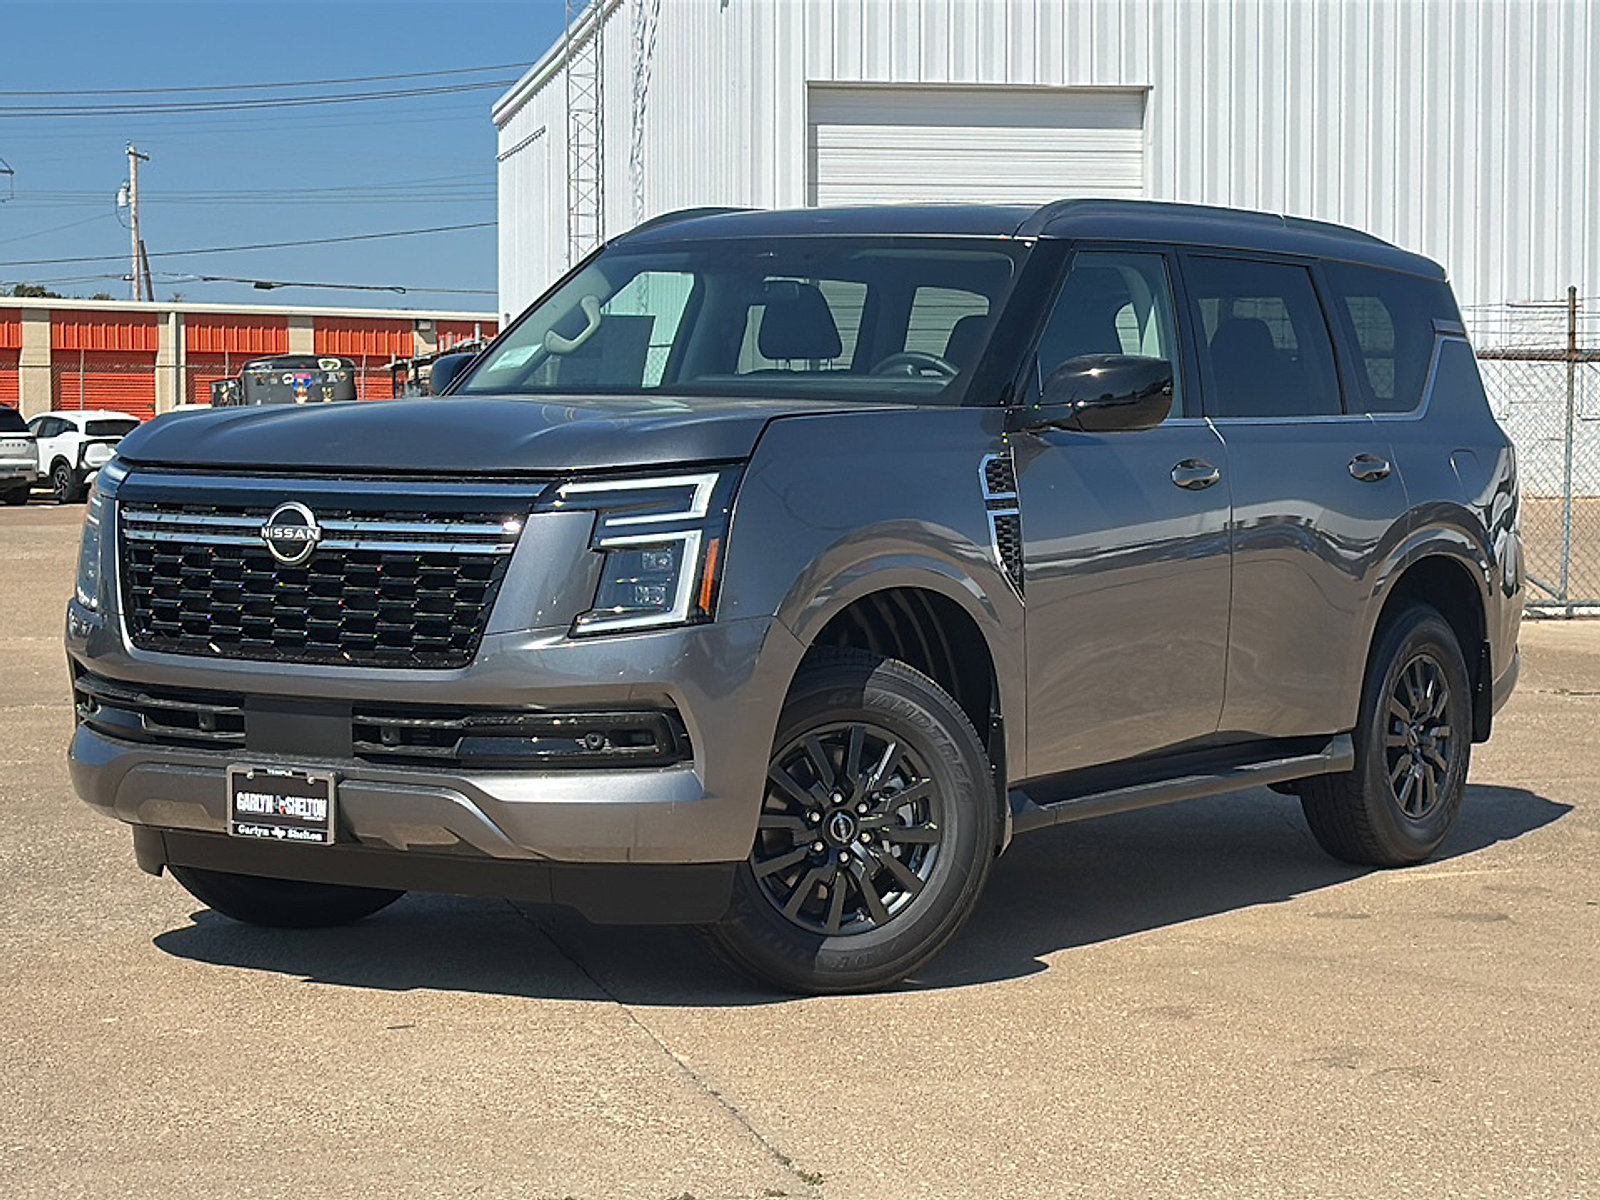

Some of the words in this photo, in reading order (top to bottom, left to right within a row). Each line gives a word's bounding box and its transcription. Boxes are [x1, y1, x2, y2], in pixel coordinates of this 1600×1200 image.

[261, 527, 321, 540] NISSAN
[236, 791, 274, 813] GARLYN
[285, 796, 327, 818] SHELTON
[238, 824, 270, 837] Garlyn
[287, 829, 323, 841] Shelton
